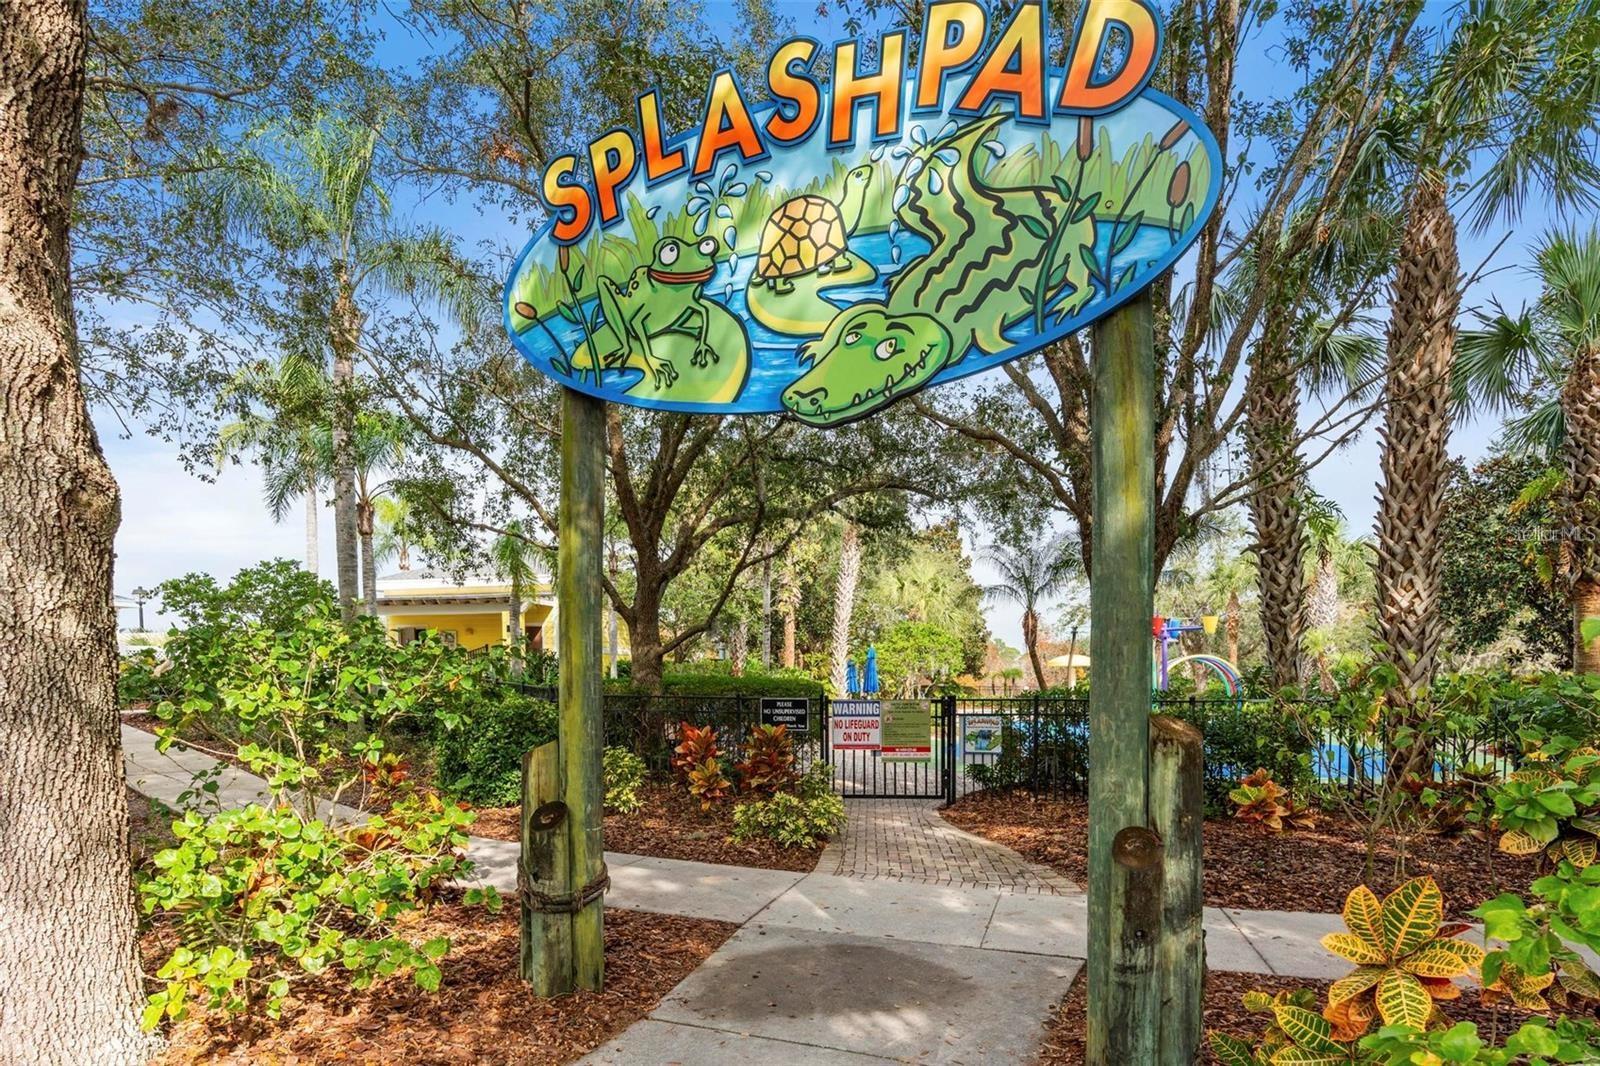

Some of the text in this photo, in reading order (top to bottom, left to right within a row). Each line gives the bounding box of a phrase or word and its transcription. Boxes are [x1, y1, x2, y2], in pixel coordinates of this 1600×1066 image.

[541, 0, 1163, 245] SPLASHPAD
[833, 702, 880, 715] WARNING
[834, 719, 844, 729] NO
[845, 719, 880, 729] LIFEGUARD
[842, 732, 871, 742] ON DUTY
